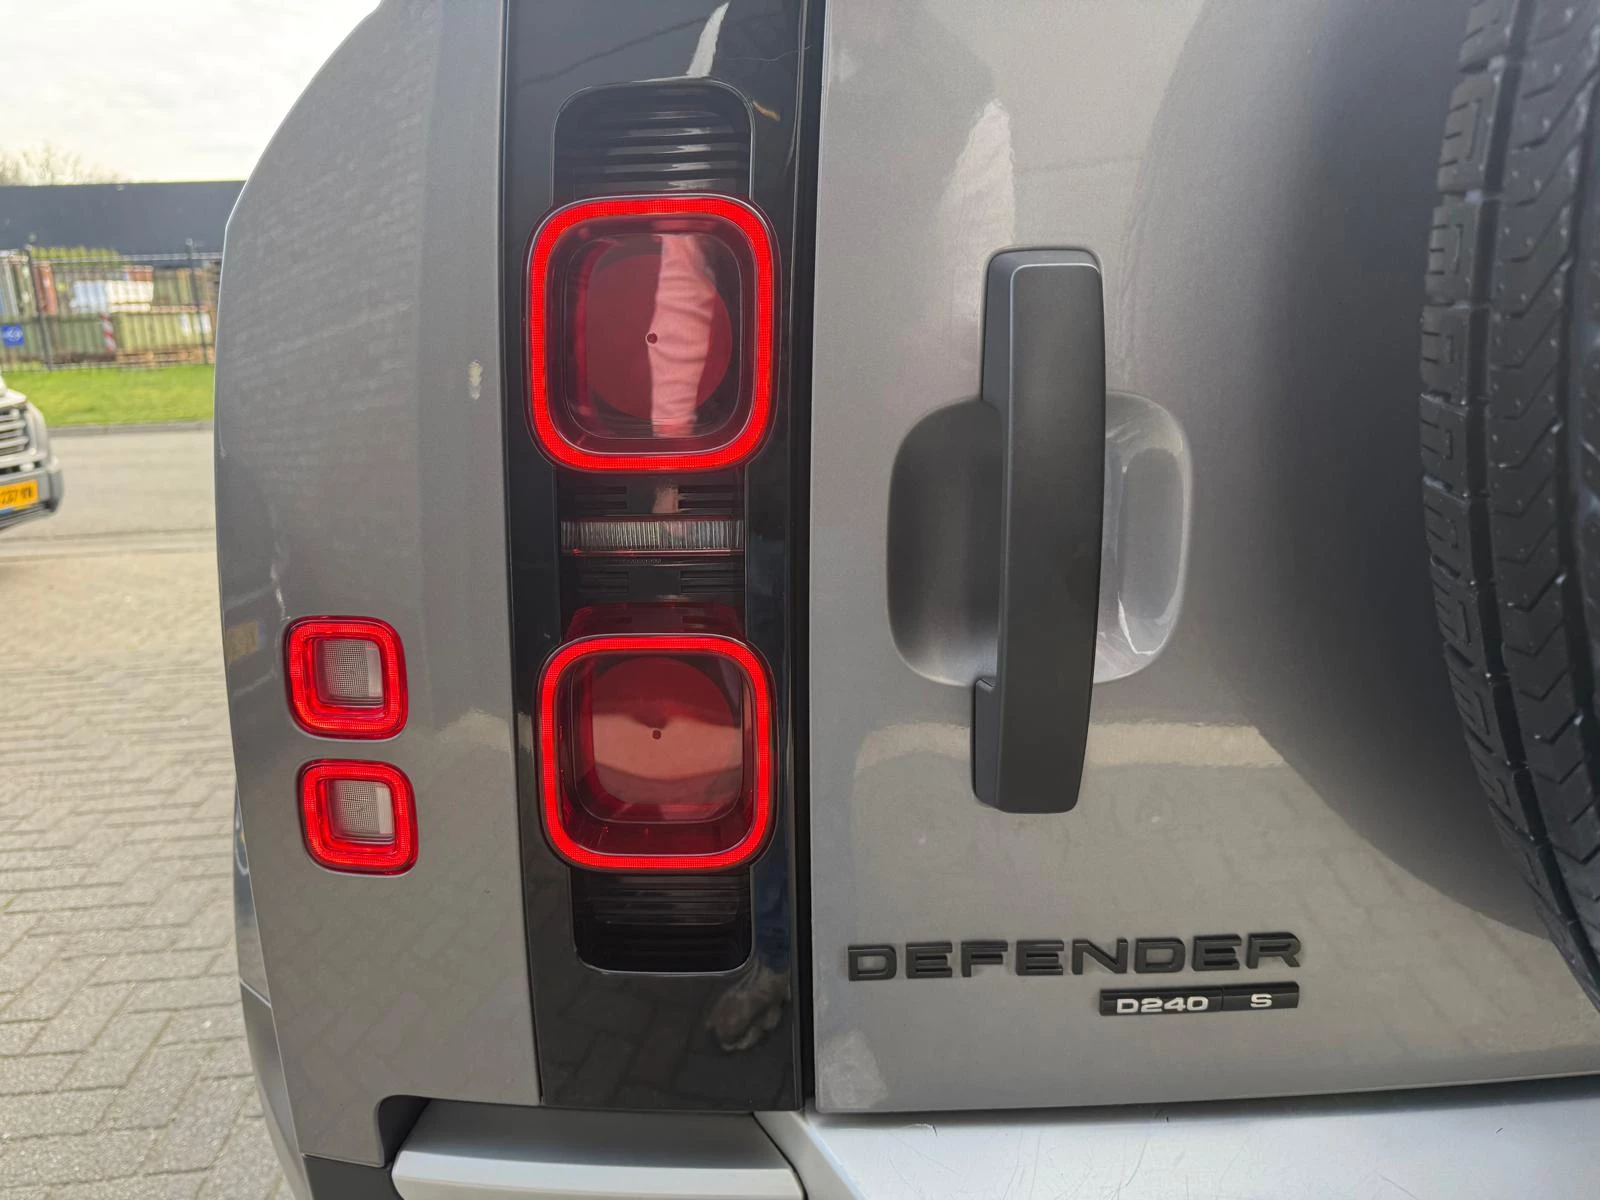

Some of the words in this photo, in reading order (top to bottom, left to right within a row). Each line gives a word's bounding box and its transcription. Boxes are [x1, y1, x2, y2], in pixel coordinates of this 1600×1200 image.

[848, 932, 1301, 981] DEFENDER
[1116, 996, 1209, 1014] D240
[1250, 993, 1273, 1008] S
